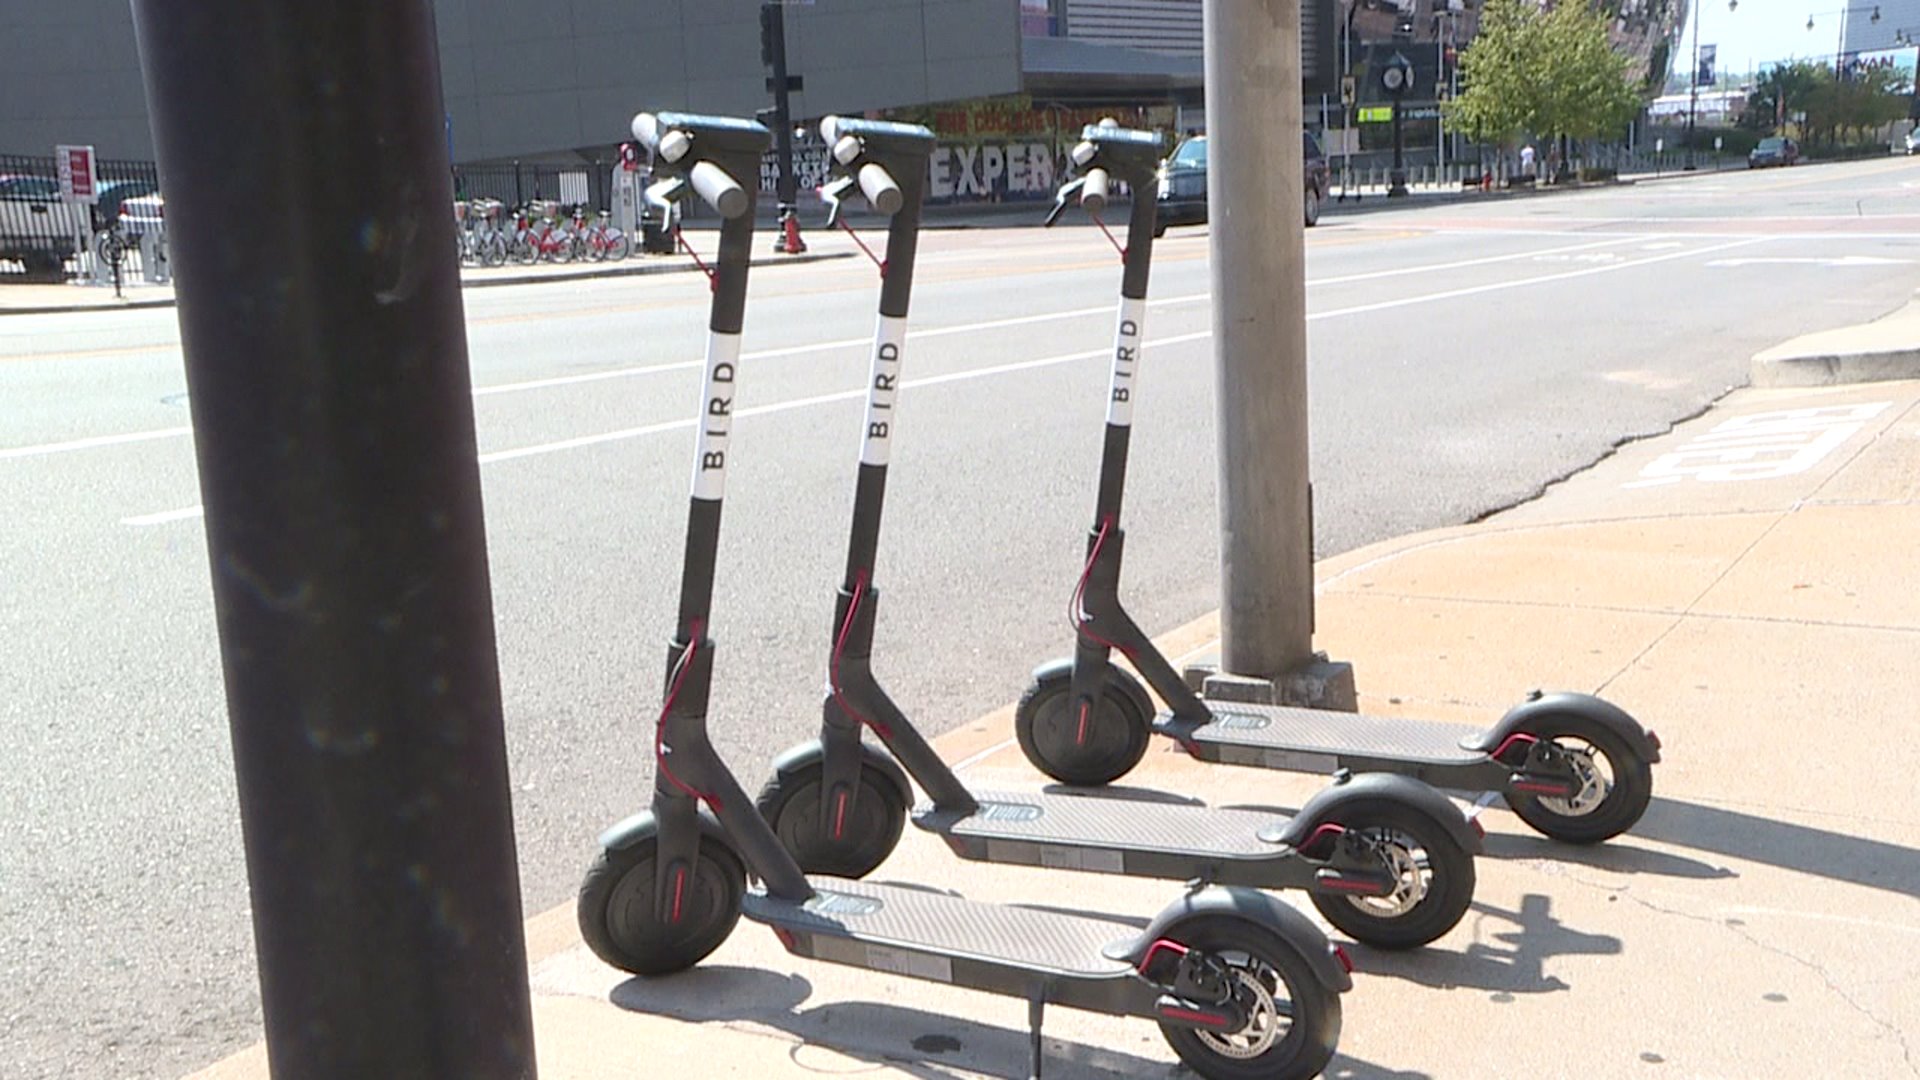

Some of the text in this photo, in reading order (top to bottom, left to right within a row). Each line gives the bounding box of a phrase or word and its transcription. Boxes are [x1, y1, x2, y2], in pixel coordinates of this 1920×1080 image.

[929, 142, 1055, 196] EXPER
[868, 342, 899, 440] BIRD
[1112, 320, 1138, 402] BIRD
[702, 362, 735, 472] BIRD
